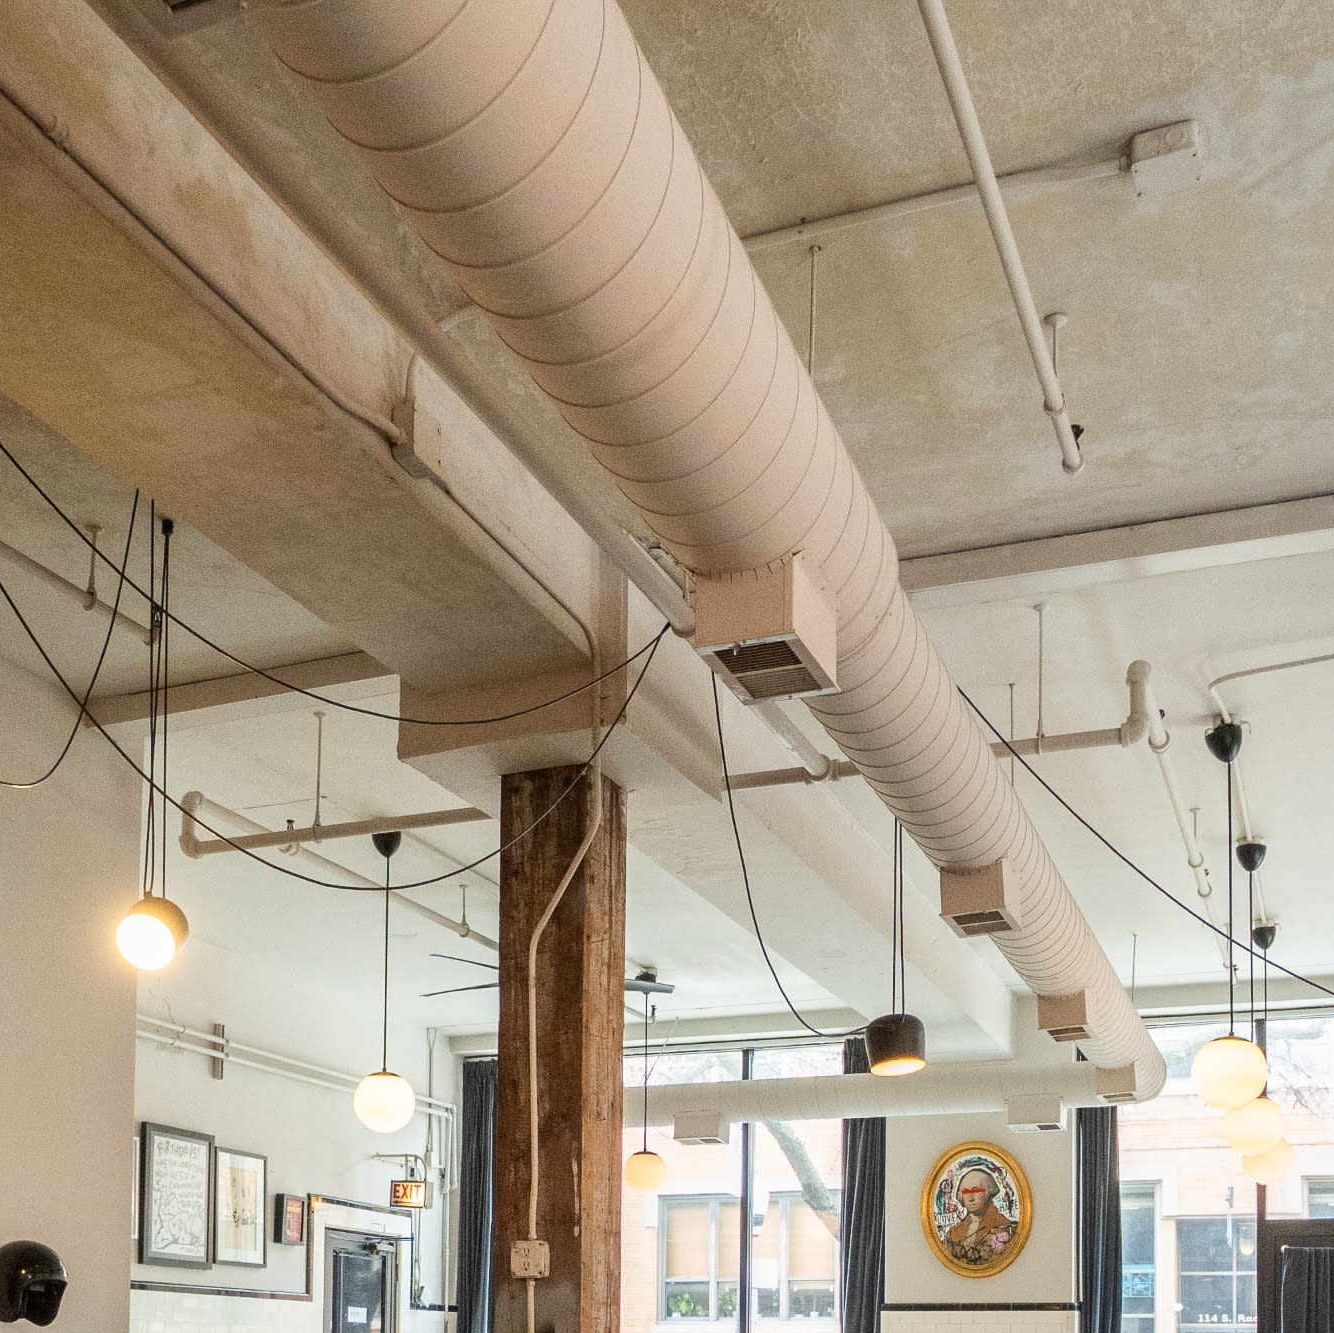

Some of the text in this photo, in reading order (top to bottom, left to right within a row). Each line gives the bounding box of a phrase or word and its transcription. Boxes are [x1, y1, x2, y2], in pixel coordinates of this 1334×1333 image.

[393, 1183, 422, 1200] EXIT
[999, 1200, 1018, 1211] HAE
[1198, 1313, 1218, 1323] 114
[1221, 1313, 1232, 1323] S.
